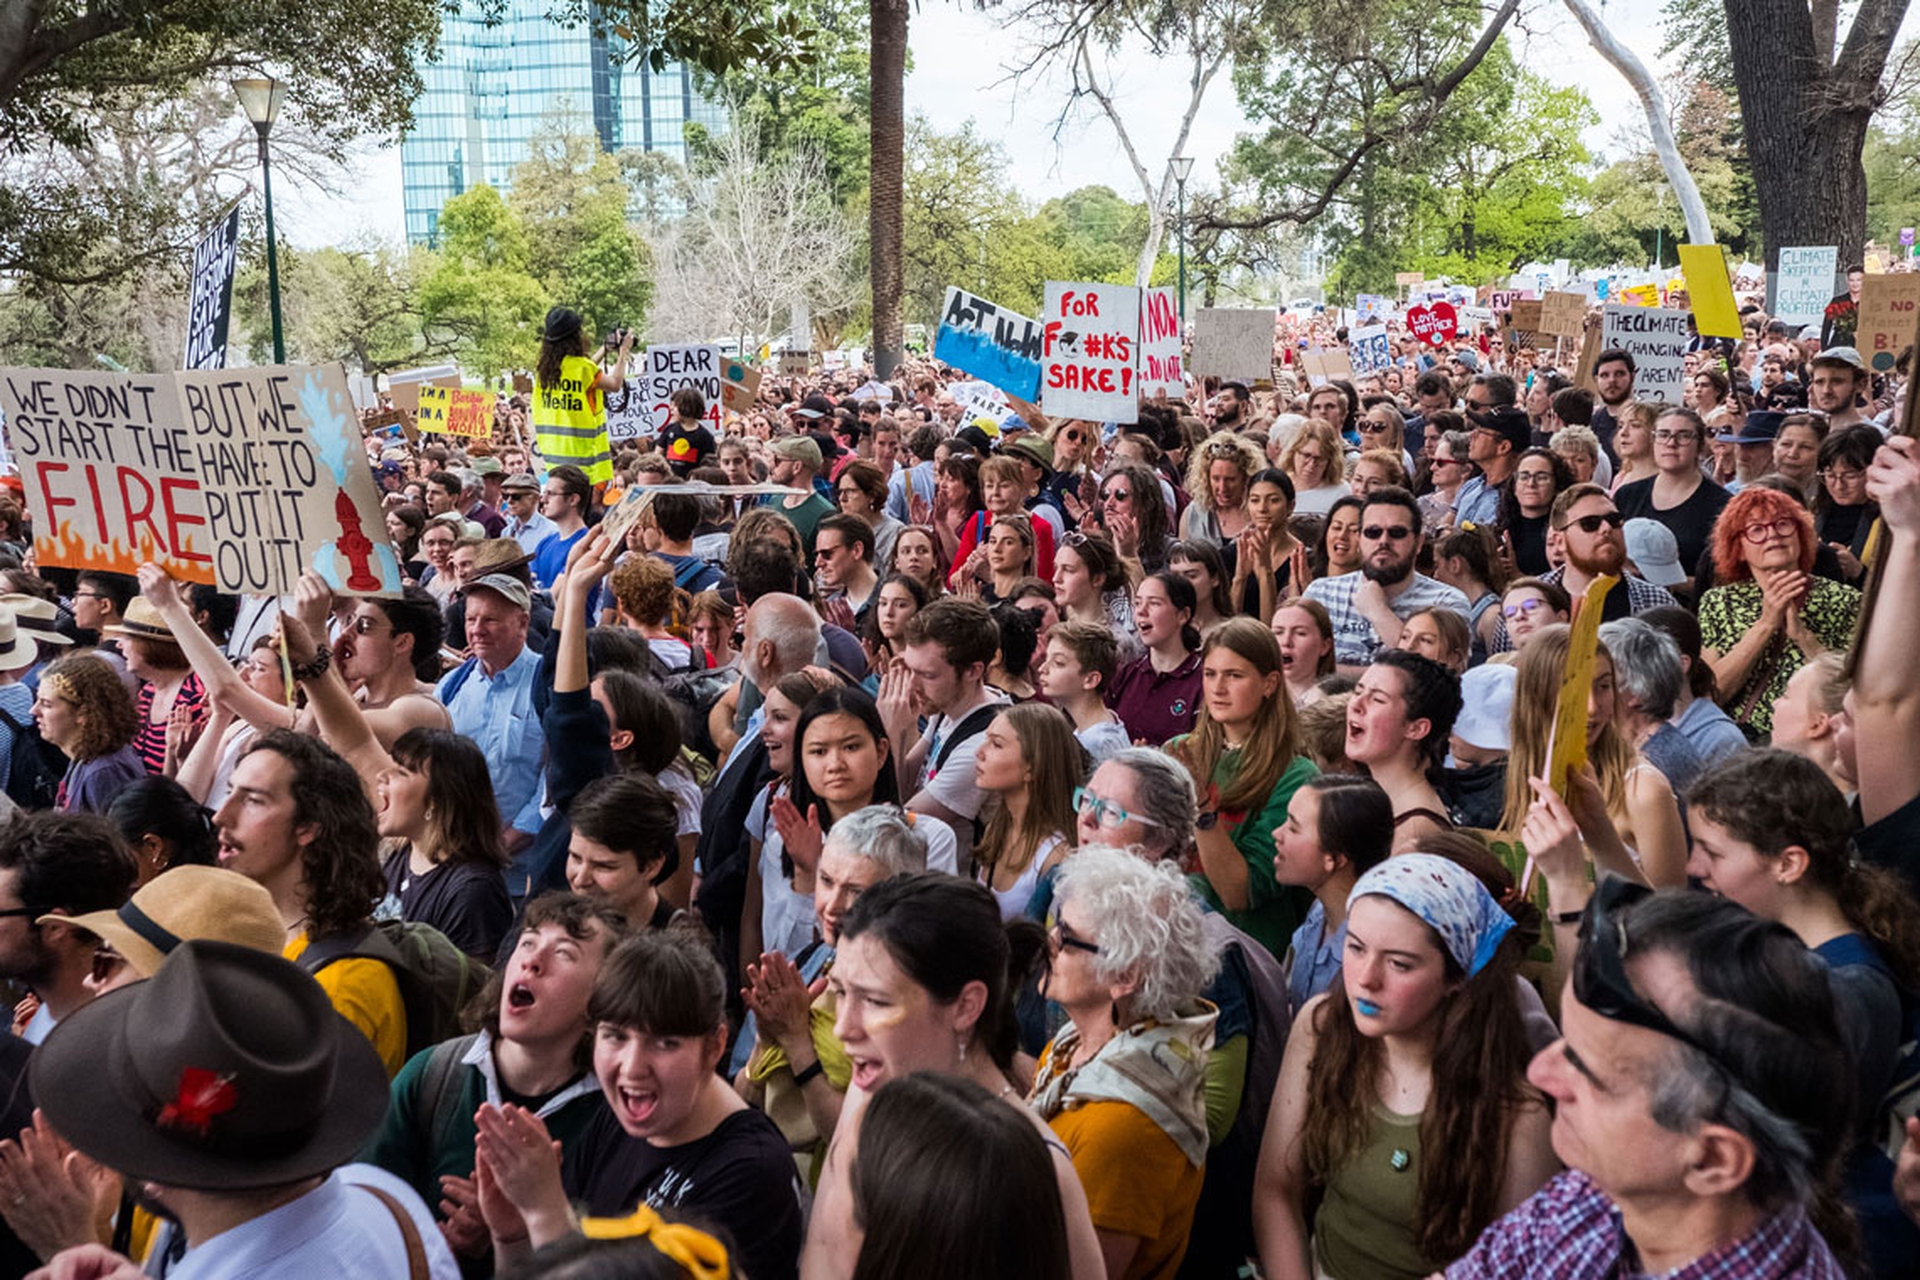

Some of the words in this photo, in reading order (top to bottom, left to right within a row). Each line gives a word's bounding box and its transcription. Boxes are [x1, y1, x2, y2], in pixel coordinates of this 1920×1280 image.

[1781, 250, 1834, 266] CLIMATE
[192, 284, 223, 338] SAVE
[1147, 292, 1177, 343] NOW
[1890, 301, 1915, 311] NO
[1411, 311, 1438, 325] LOVE
[1414, 319, 1455, 335] MOTHER
[653, 350, 712, 373] DEAR
[1641, 366, 1684, 383] AREN'T
[7, 377, 59, 413] WE
[64, 380, 155, 424] DIDN'T
[438, 389, 446, 400] A
[185, 382, 248, 438] BUT
[246, 377, 303, 433] WE
[435, 409, 443, 420] A
[609, 421, 637, 437] LESS
[15, 414, 115, 463] START
[125, 425, 196, 473] THE
[197, 441, 272, 486] HAVE
[268, 441, 316, 488] TO
[36, 461, 213, 563] FIRE
[205, 490, 261, 541] PUT
[273, 489, 304, 541] IT
